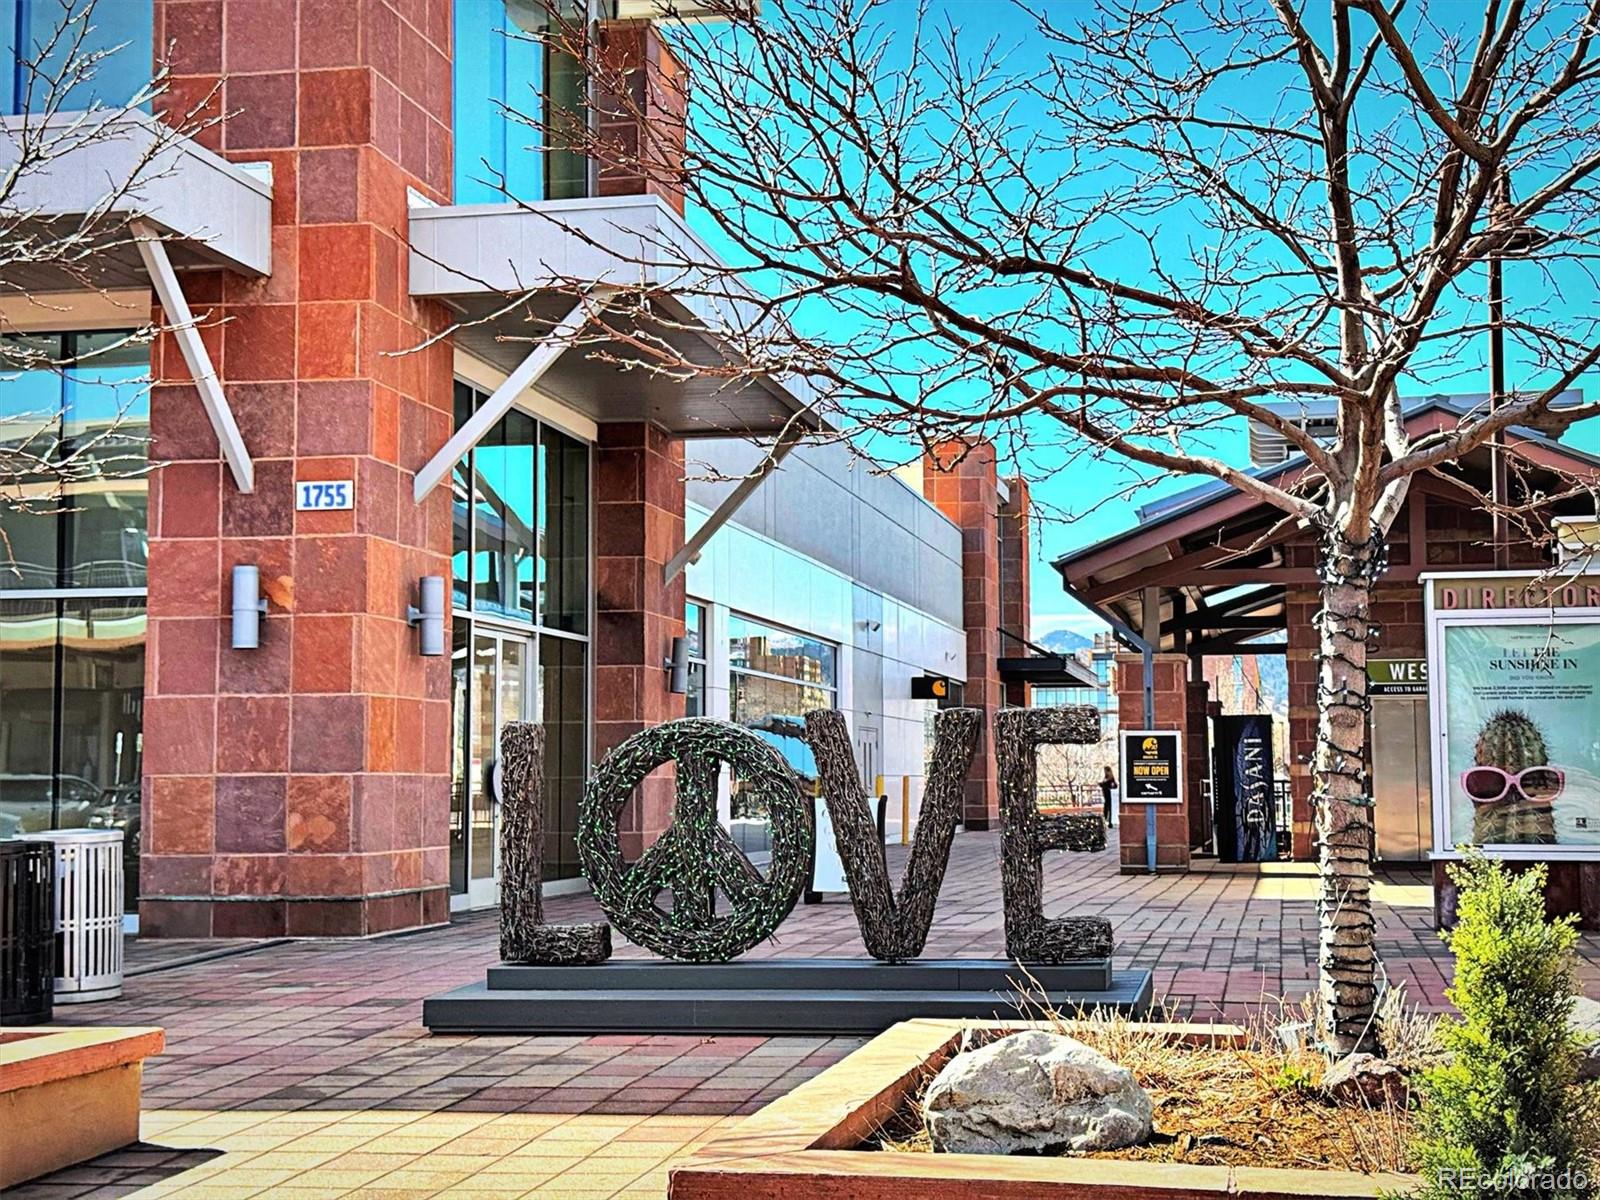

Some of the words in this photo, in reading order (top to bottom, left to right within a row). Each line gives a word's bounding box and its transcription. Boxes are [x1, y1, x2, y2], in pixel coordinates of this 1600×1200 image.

[302, 483, 347, 508] 1755
[1443, 584, 1600, 609] DIRECTOR
[1503, 647, 1528, 658] LET
[1531, 646, 1560, 658] THE
[1489, 658, 1560, 670] SUNSHINE
[1563, 658, 1578, 669] IN
[1133, 766, 1150, 776] NOW
[1151, 766, 1169, 776] OPEN
[1240, 738, 1269, 823] DASANI
